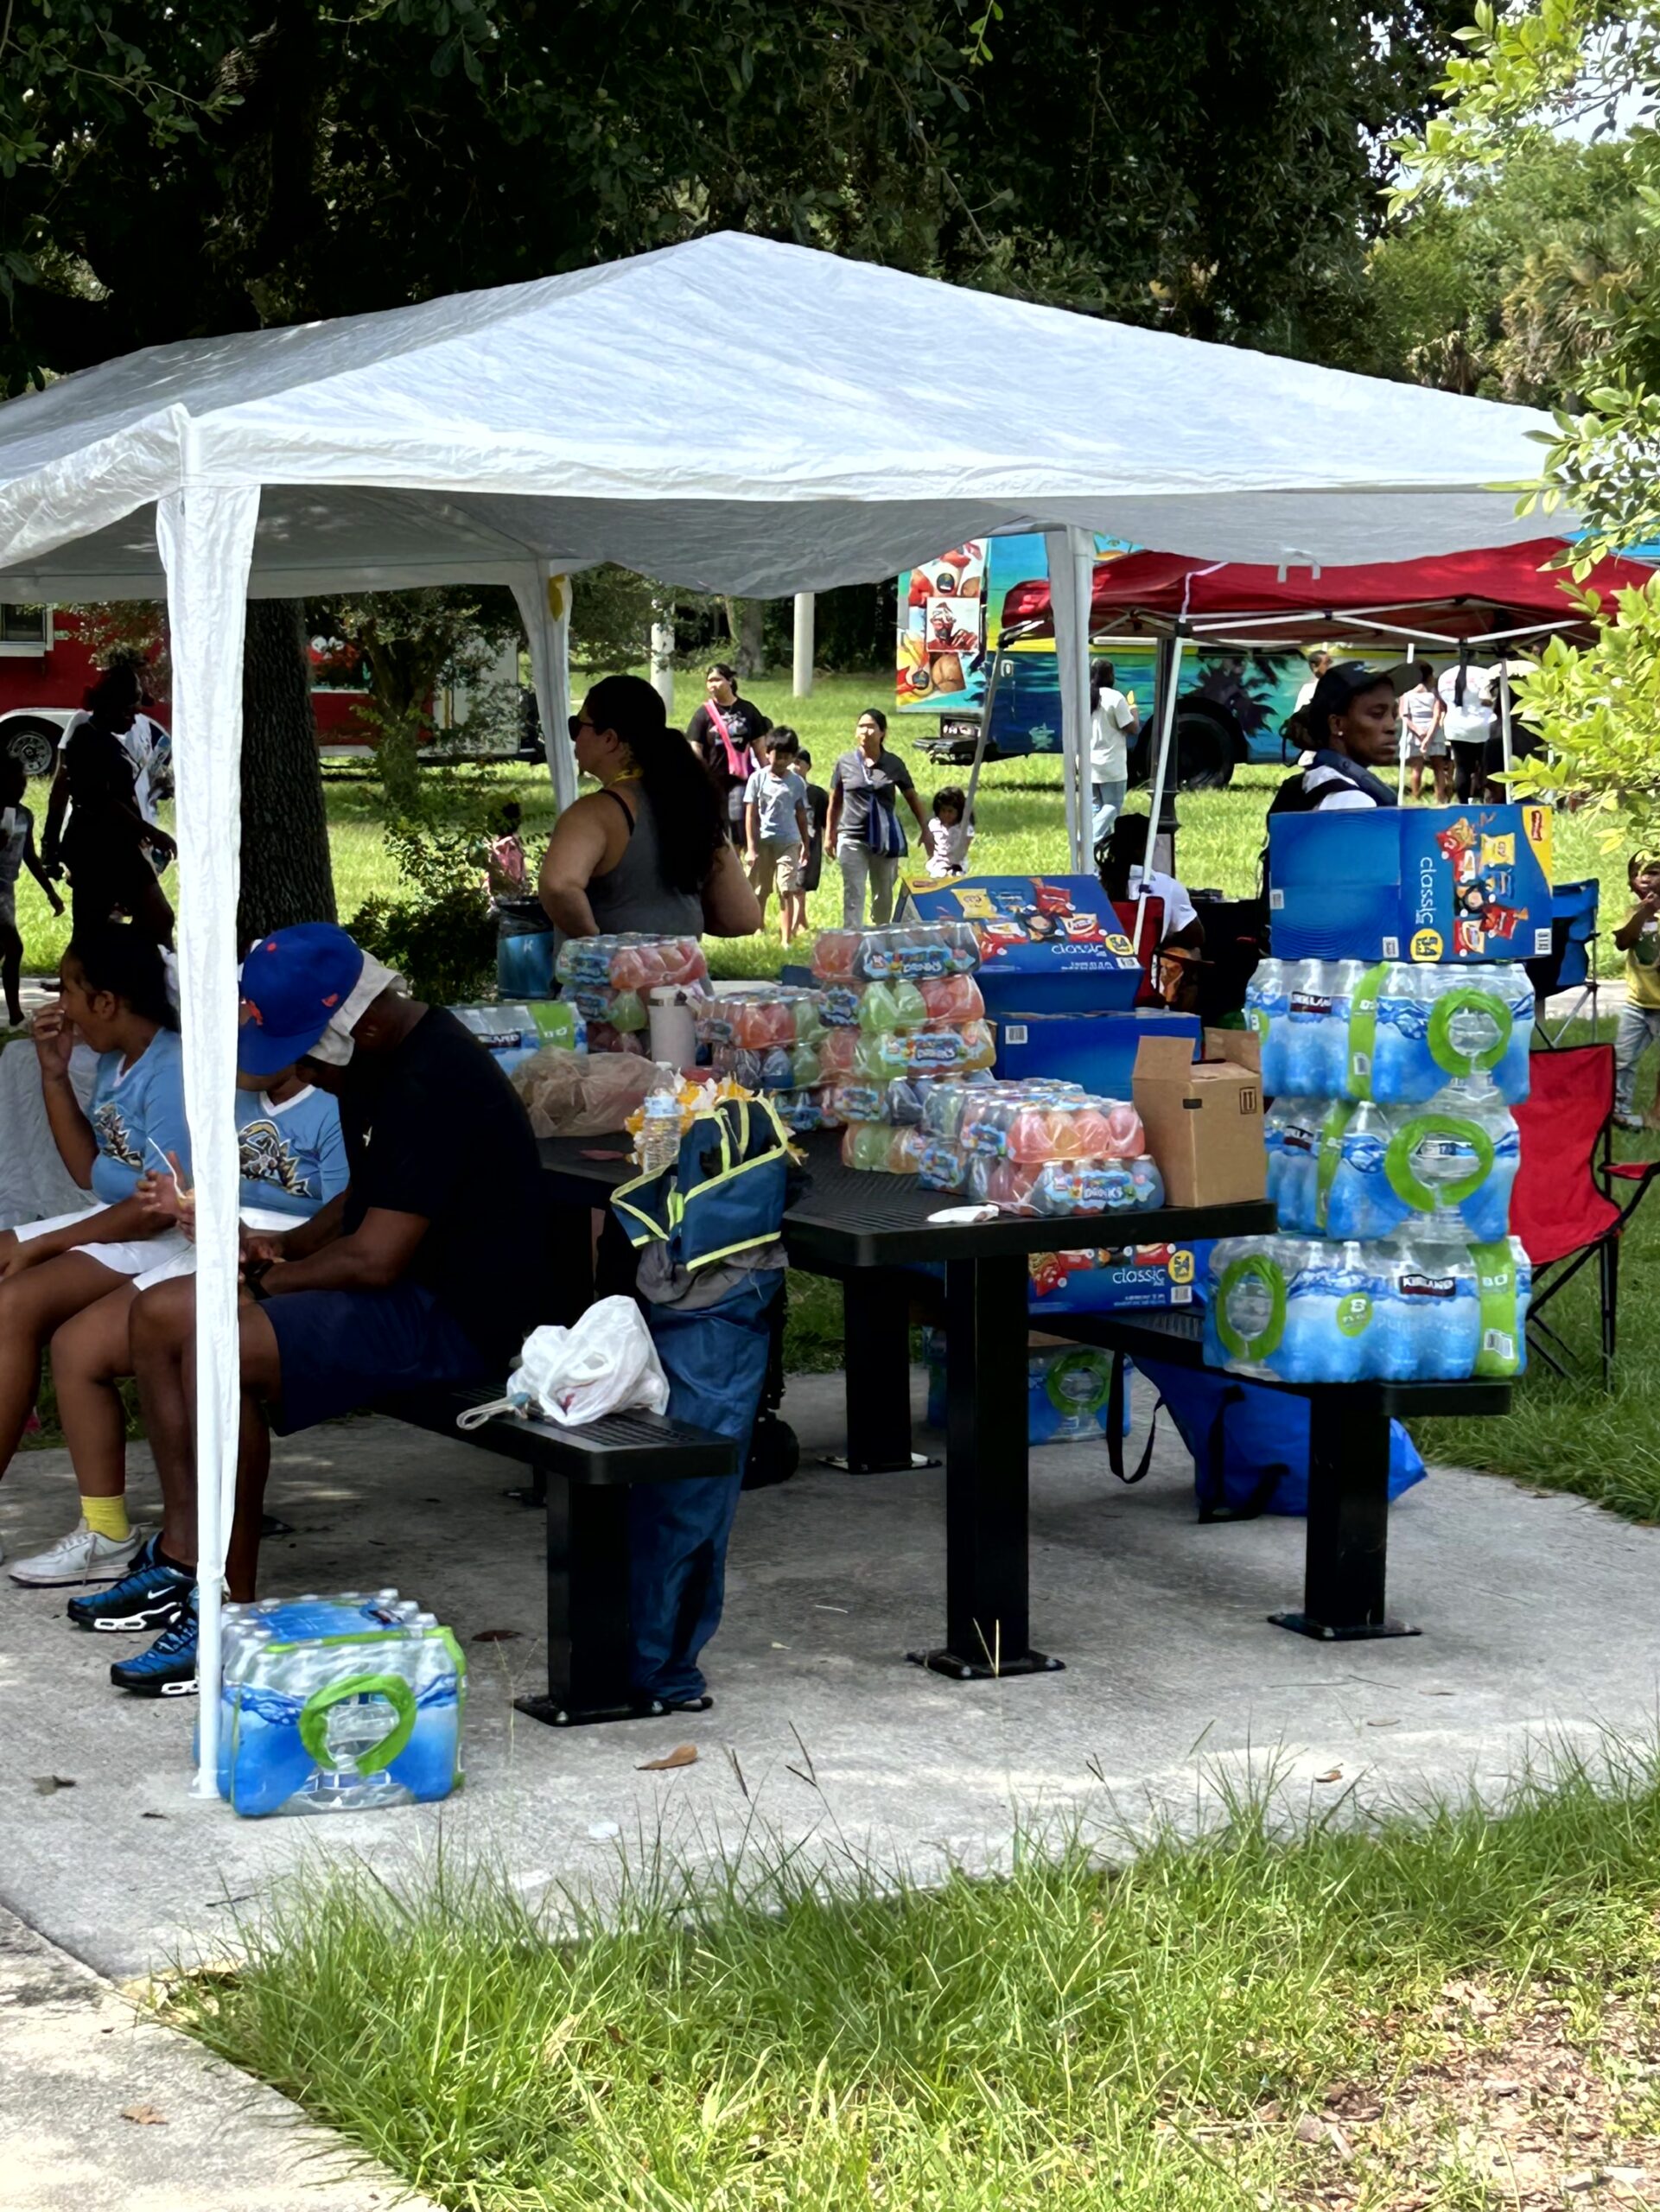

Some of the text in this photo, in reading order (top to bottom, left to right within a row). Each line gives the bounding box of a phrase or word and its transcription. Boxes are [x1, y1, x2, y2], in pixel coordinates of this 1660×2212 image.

[1420, 856, 1437, 924] classic
[1051, 943, 1106, 955] classic
[1112, 1266, 1166, 1284] classic
[1350, 1298, 1368, 1313] 8
